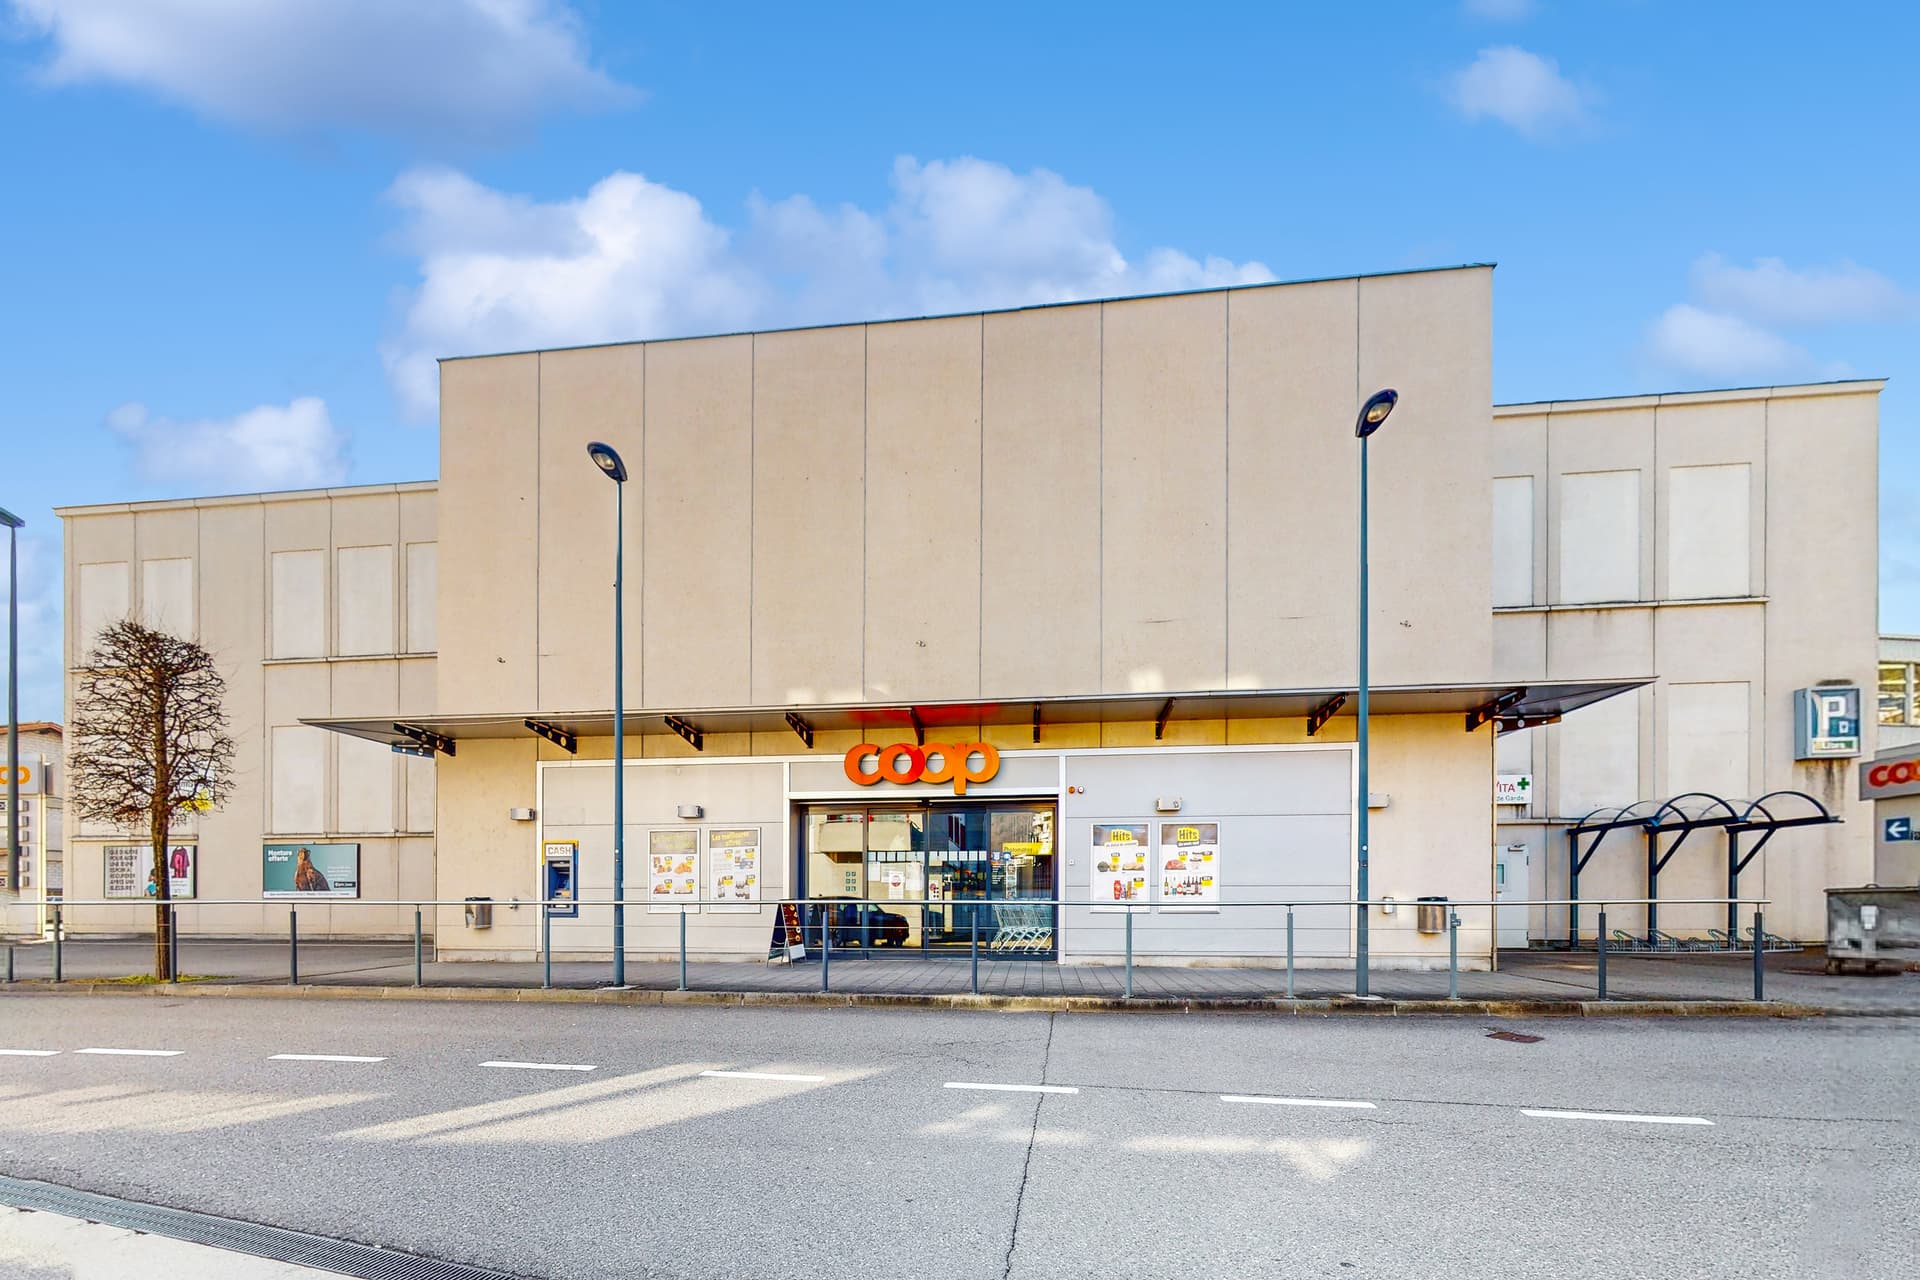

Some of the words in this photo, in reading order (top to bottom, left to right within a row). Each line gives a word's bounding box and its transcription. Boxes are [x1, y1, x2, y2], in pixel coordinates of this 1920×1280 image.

[1822, 696, 1846, 736] P
[844, 742, 1000, 795] coop
[1497, 781, 1516, 792] ITA
[1112, 831, 1131, 841] Hits
[1178, 829, 1198, 840] Hits
[547, 846, 571, 855] CASH
